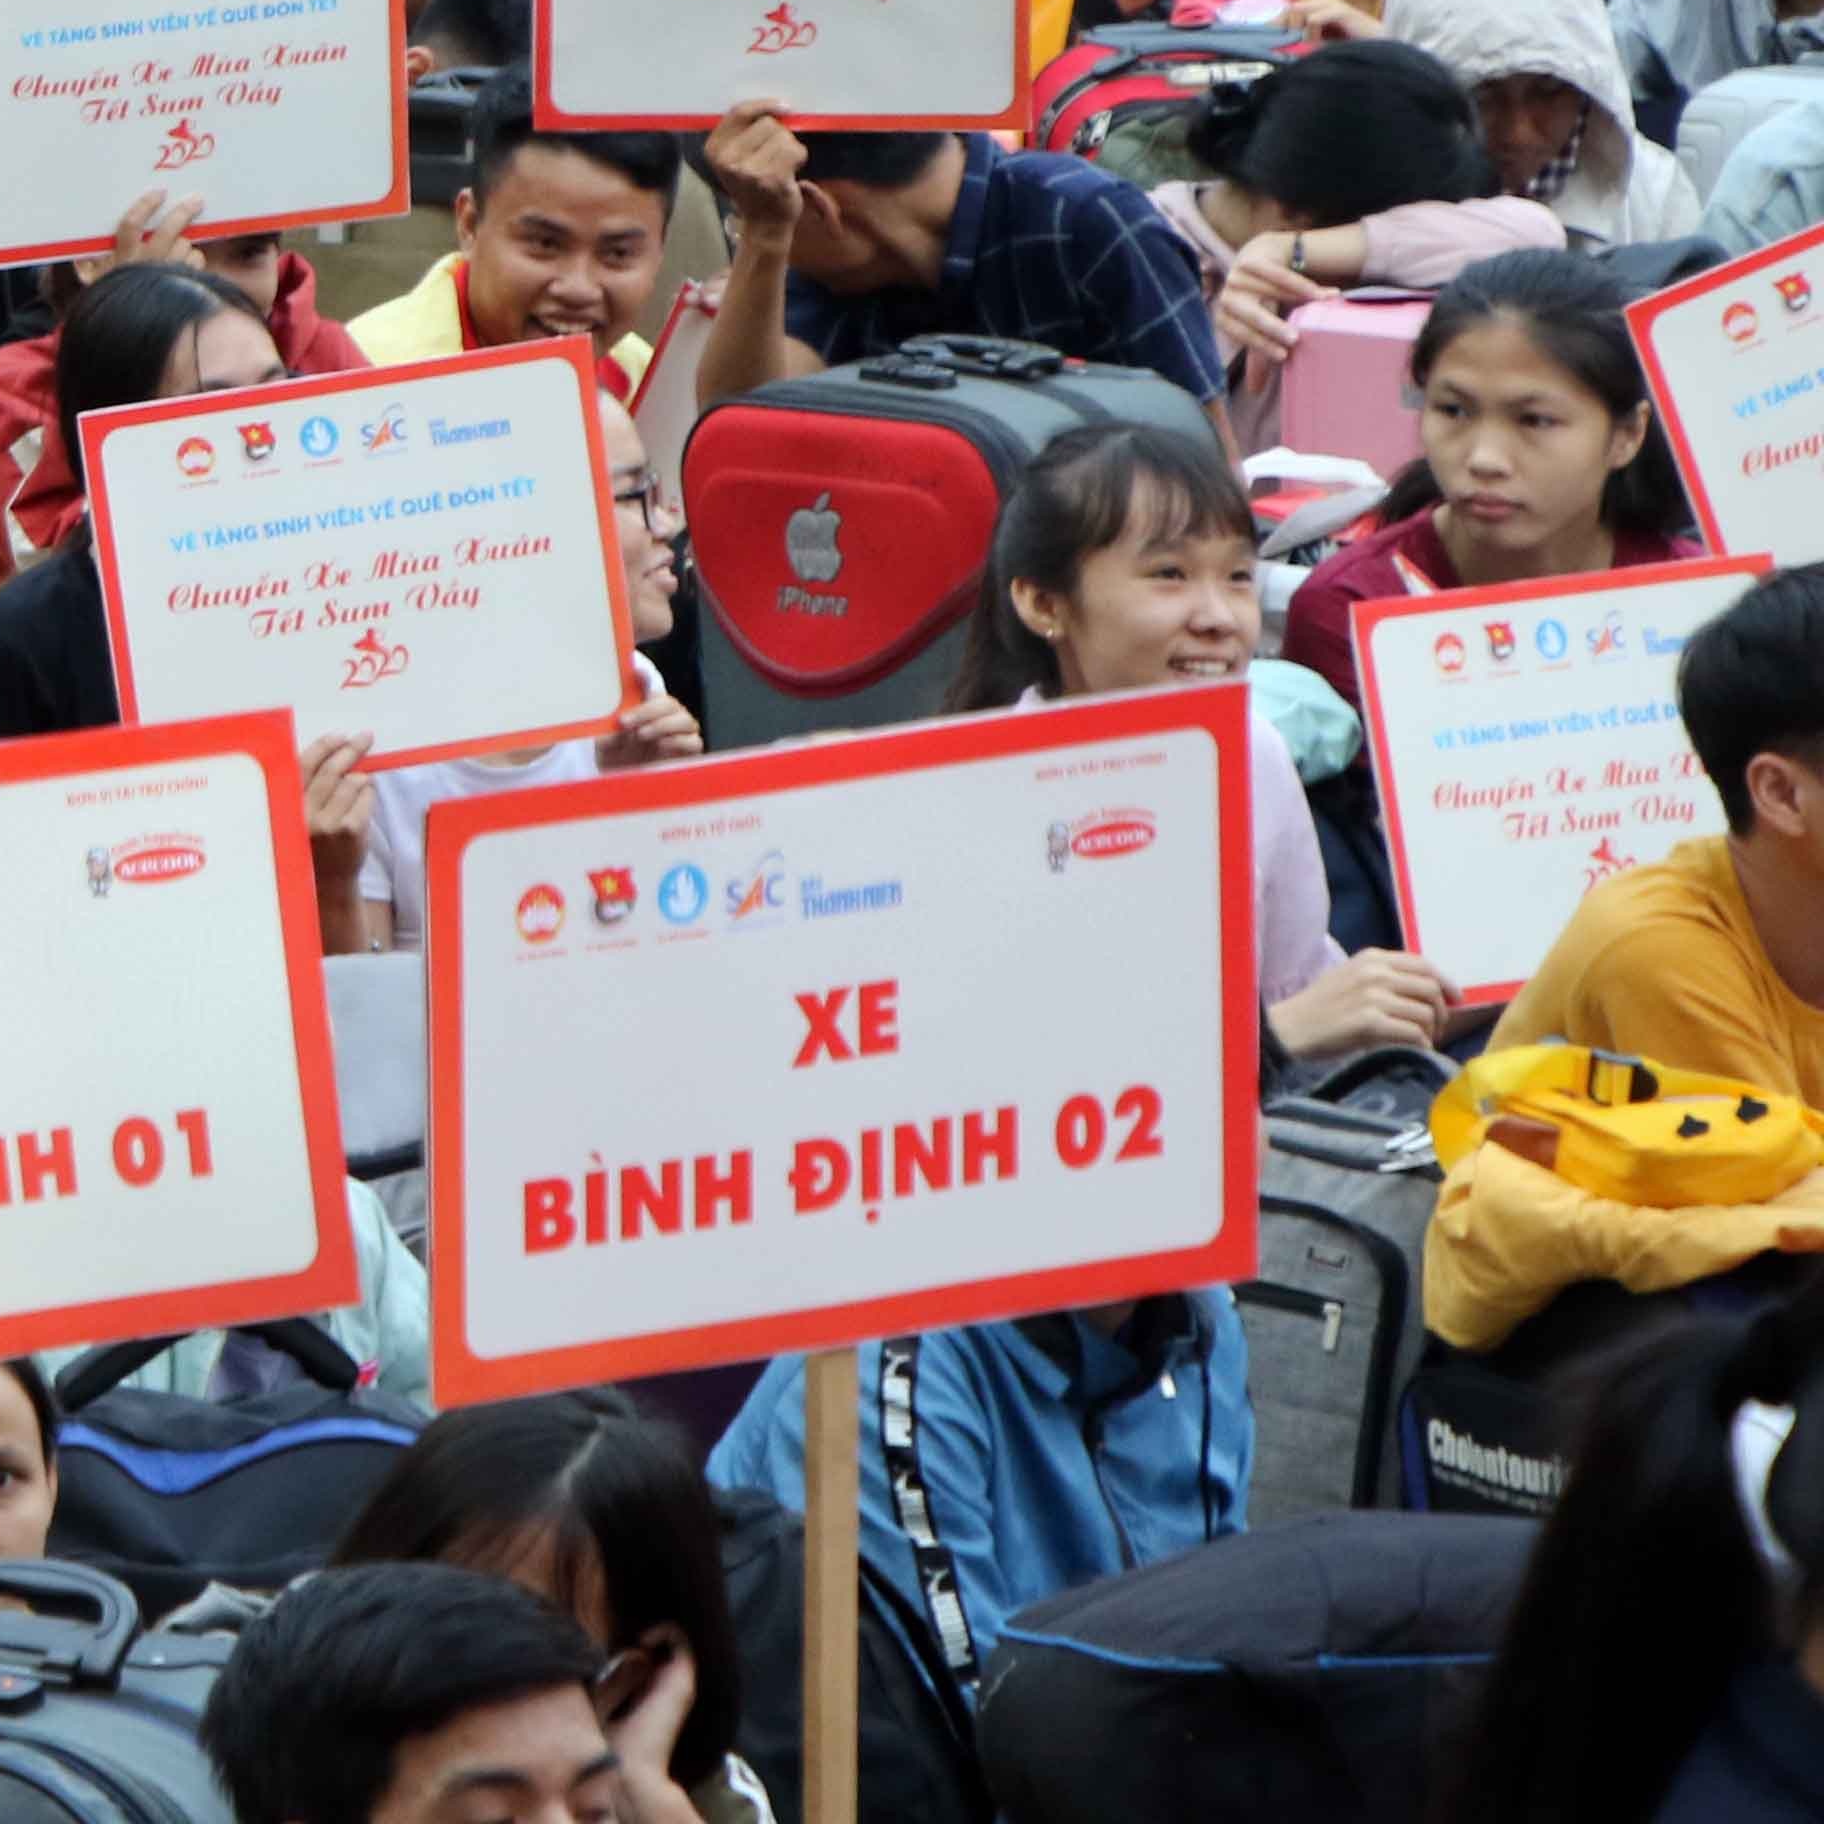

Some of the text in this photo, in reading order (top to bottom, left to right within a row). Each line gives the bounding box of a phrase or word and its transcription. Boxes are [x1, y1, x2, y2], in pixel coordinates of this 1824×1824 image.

[101, 20, 145, 40] SINH
[139, 92, 205, 118] Sum
[263, 512, 312, 540] SINH
[317, 599, 391, 629] Sum
[777, 585, 849, 617] iPhone
[792, 978, 900, 1069] XE
[110, 1108, 215, 1189] 01
[523, 1083, 1164, 1256] BÌNH ĐỊNH 02
[1427, 1417, 1566, 1498] Cholontouri
